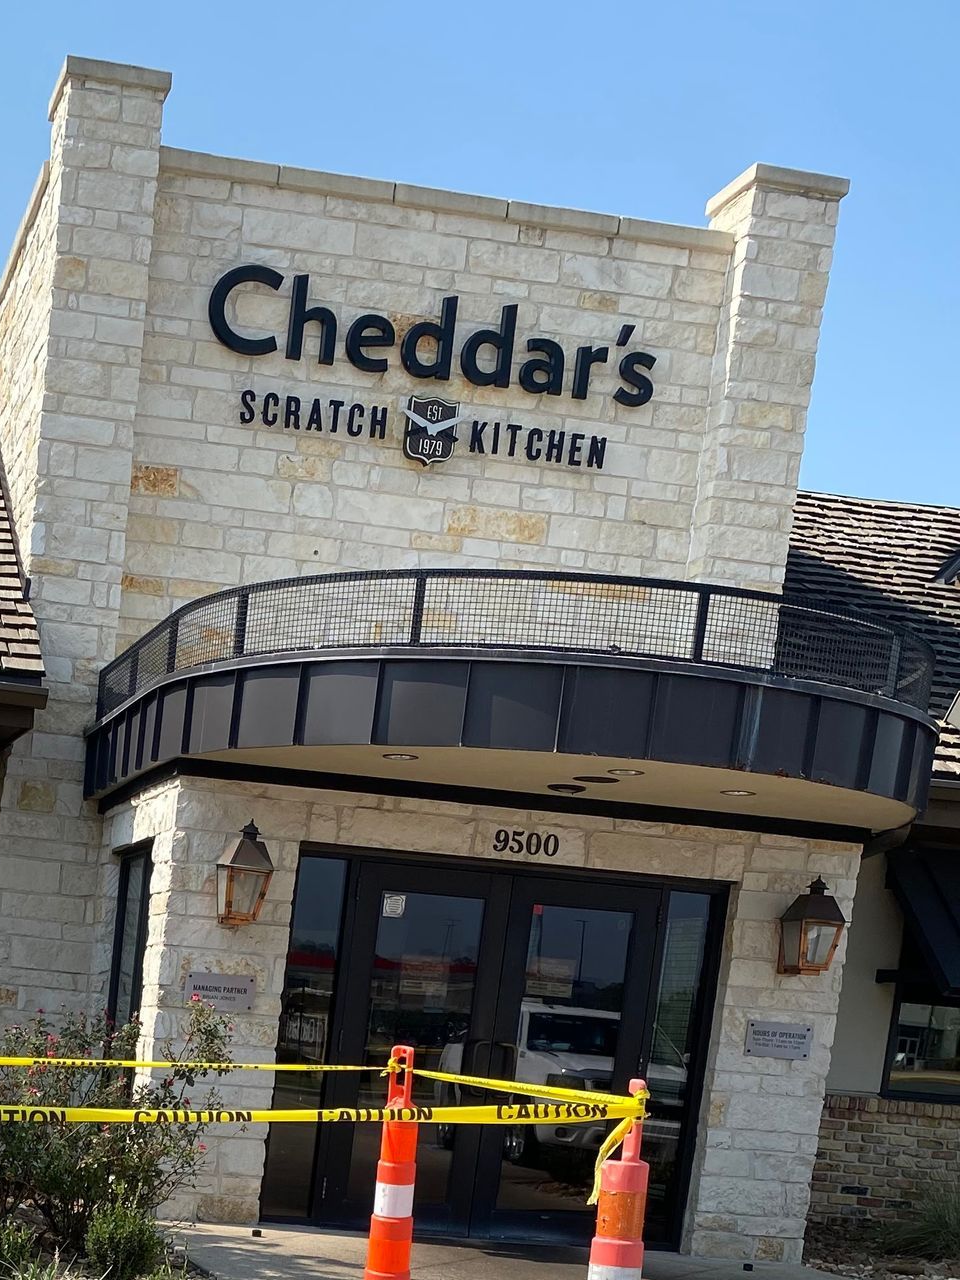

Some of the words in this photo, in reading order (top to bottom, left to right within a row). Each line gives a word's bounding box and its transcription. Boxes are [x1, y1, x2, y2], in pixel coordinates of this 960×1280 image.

[209, 265, 656, 407] Cheddar's
[240, 390, 387, 440] SCRATCH
[469, 420, 607, 469] KITCHEN
[418, 438, 443, 456] 1979
[493, 829, 559, 857] 9500
[193, 984, 222, 993] MANAGING
[223, 986, 248, 995] PARTNER
[752, 1029, 770, 1037] HOURS
[779, 1031, 807, 1040] OPERATION
[497, 1104, 608, 1119] CAUTION
